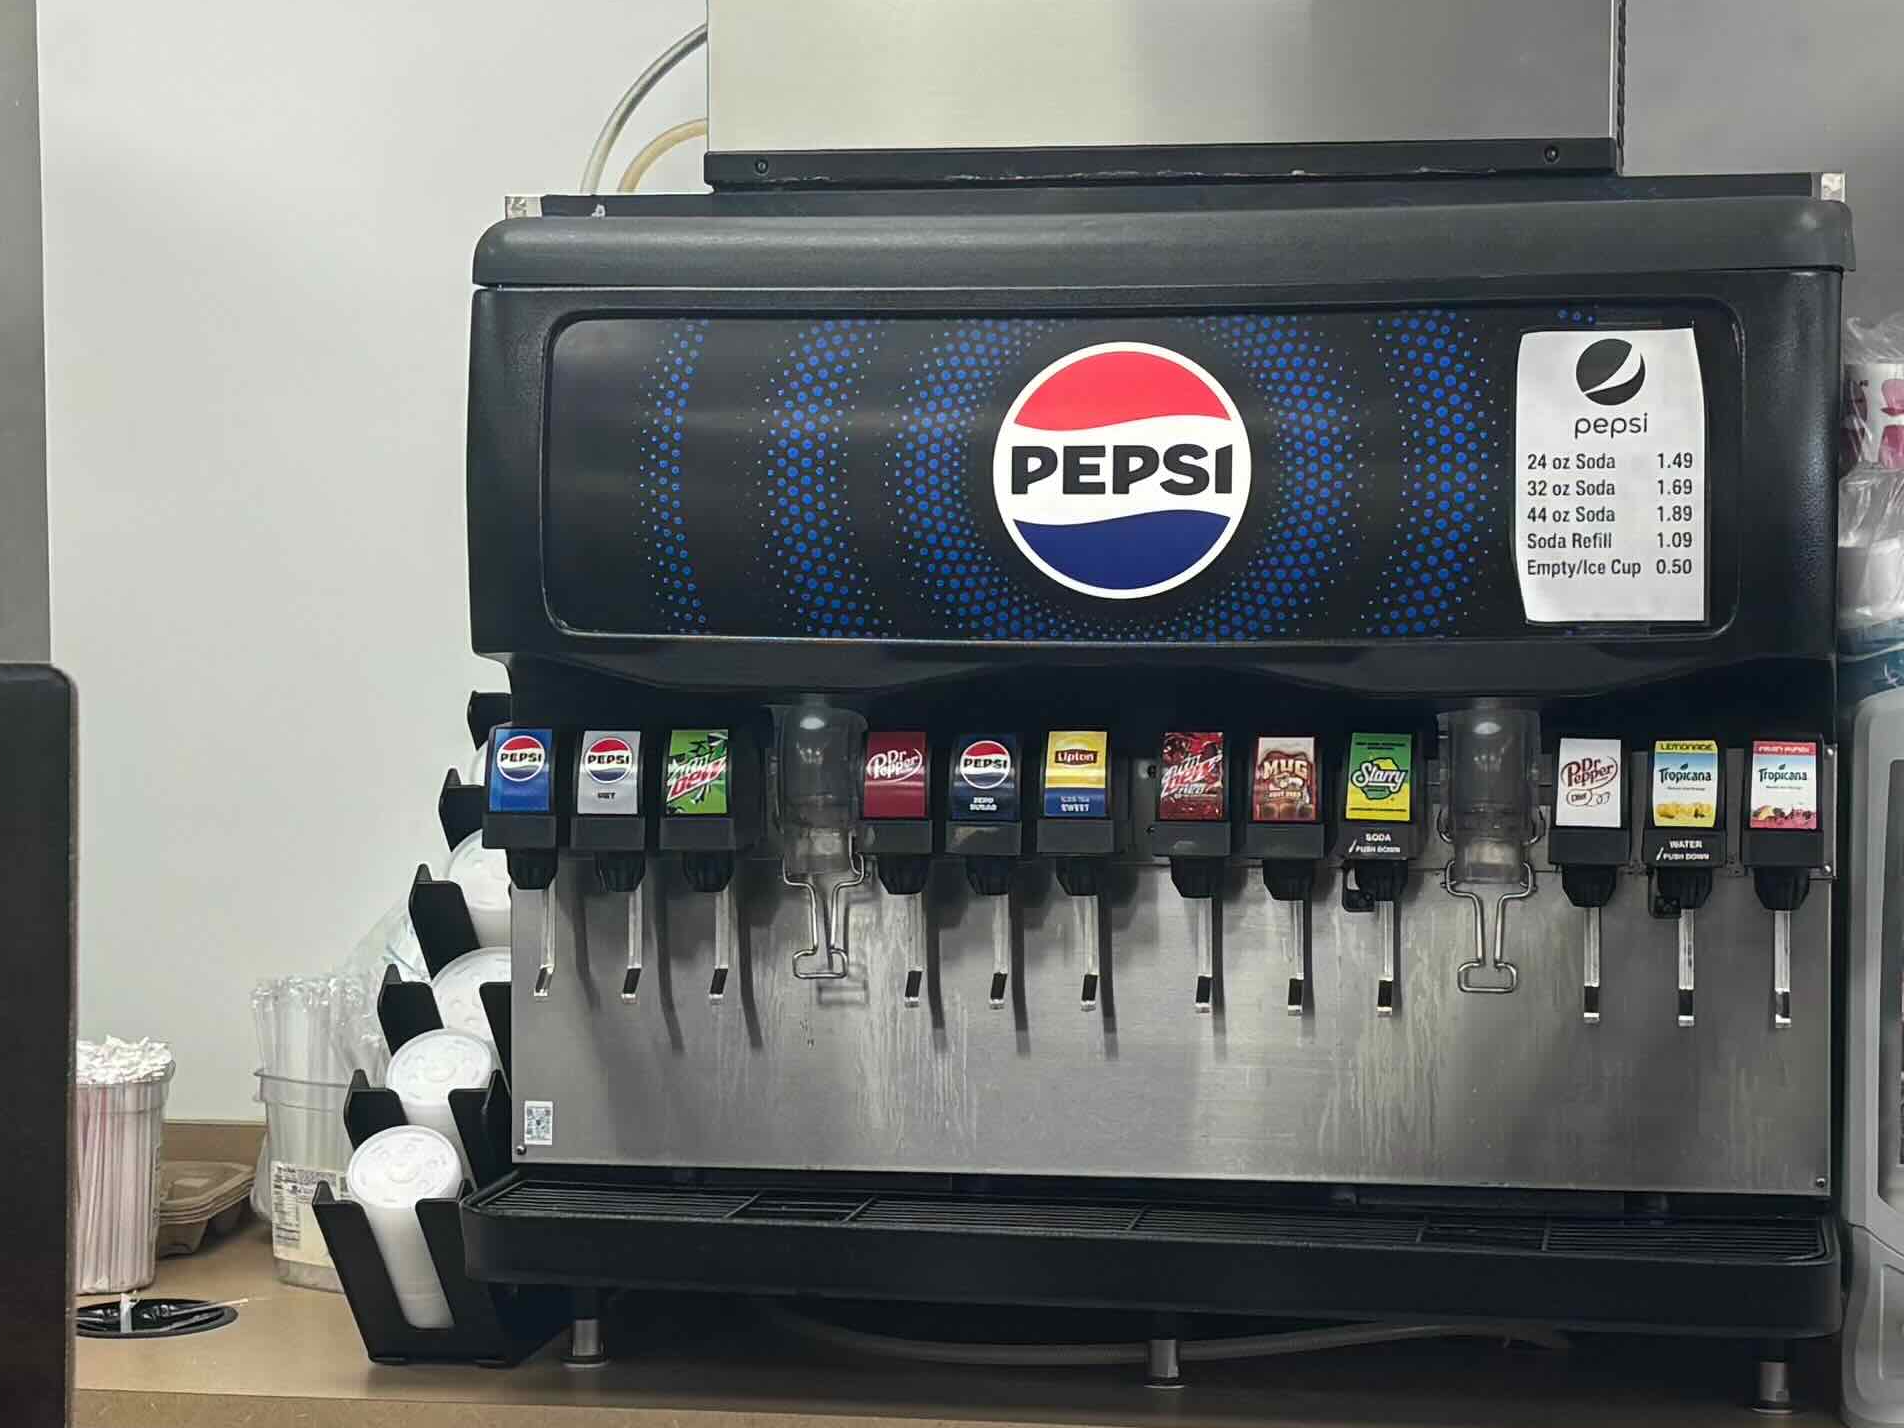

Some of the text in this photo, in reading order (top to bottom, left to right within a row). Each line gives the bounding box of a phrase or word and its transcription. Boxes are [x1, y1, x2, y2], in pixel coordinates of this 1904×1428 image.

[1574, 413, 1648, 439] pepsi
[1011, 443, 1233, 496] PEPSI
[1527, 453, 1693, 470] 24 oz Soda 1.49
[1527, 479, 1693, 496] 32 oz Soda 1.69
[1527, 505, 1693, 523] 44 oz Soda 1.89
[1527, 532, 1693, 549] Soda Refill 1.09
[1527, 558, 1693, 578] Empty/Ice Cup 0.50
[500, 752, 543, 764] PEPSI
[587, 754, 631, 765] PEPSI
[963, 757, 1008, 770] PEPSI
[1057, 751, 1094, 763] Lipton
[1263, 759, 1308, 779] MUG
[1352, 763, 1406, 791] Starry
[1659, 766, 1712, 784] Tropicana
[1758, 767, 1808, 783] Tropicana
[1365, 833, 1391, 842] SODA
[1669, 840, 1703, 849] WATER
